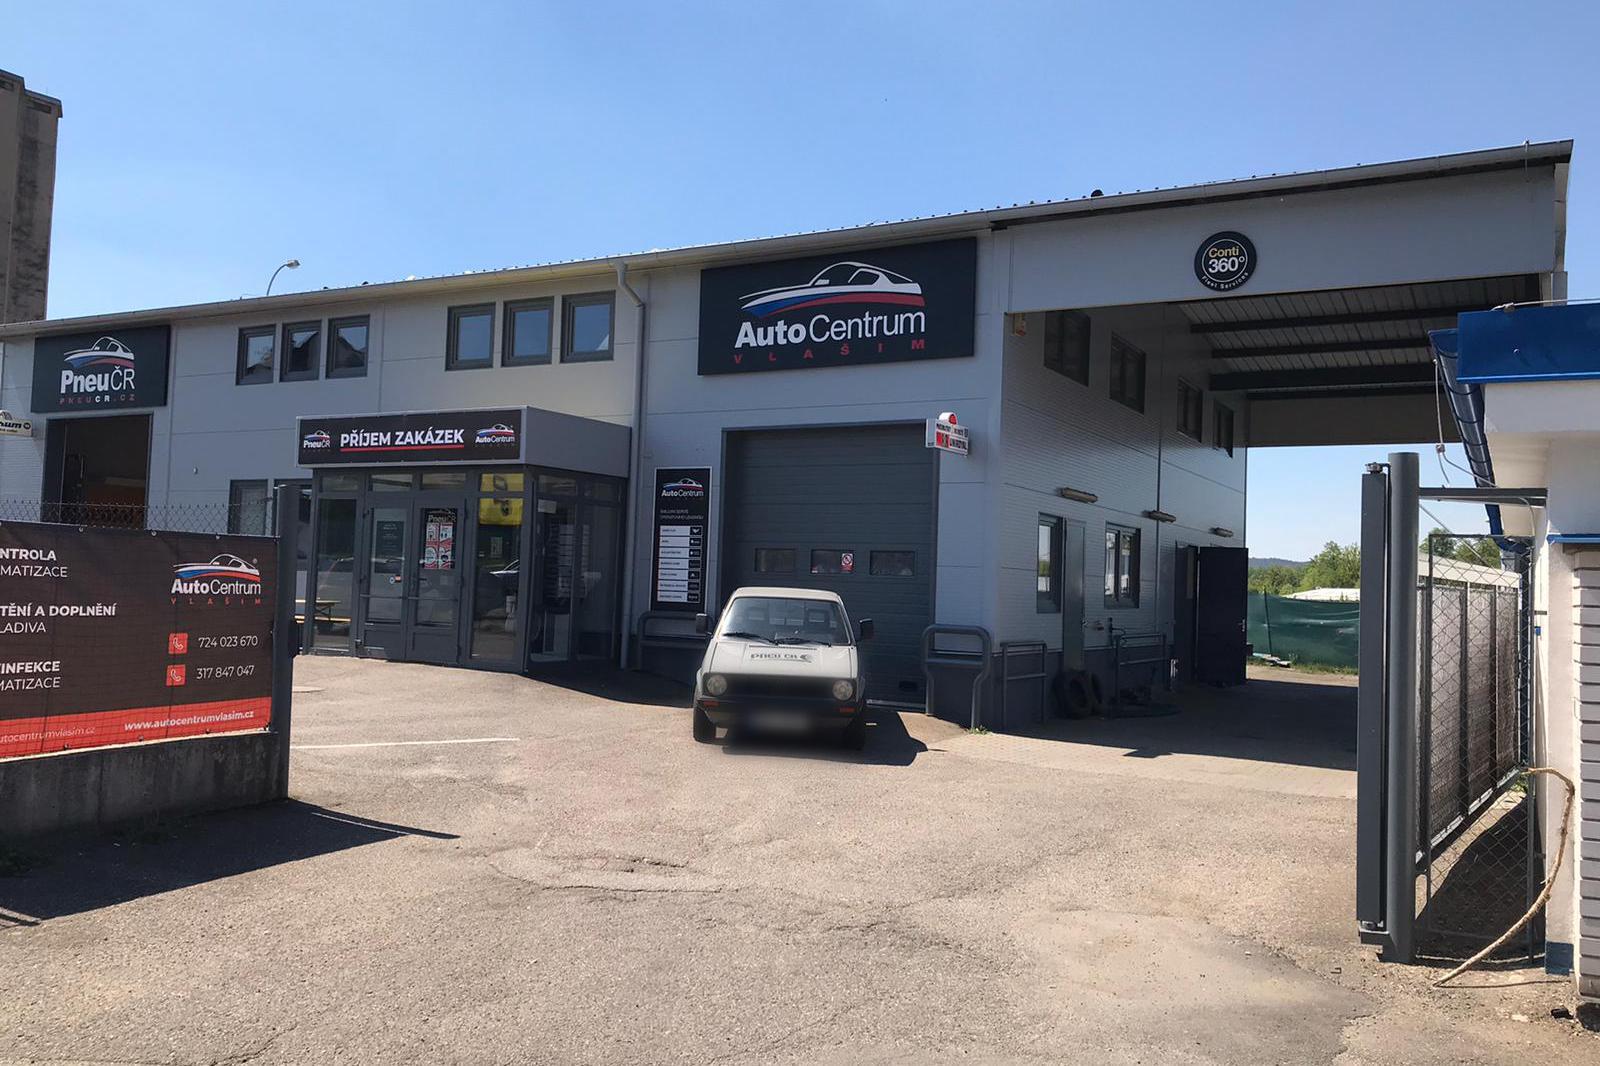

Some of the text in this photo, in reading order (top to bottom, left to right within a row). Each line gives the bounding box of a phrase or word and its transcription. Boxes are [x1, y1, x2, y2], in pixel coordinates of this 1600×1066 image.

[1208, 246, 1240, 258] Conti
[734, 310, 926, 349] AutoCentrum
[734, 339, 925, 365] VLAŠIM
[60, 365, 136, 394] PneuČR
[340, 426, 465, 448] PŘÍJEM ZAKÁZEK
[475, 435, 516, 444] AutoCentrum
[661, 489, 705, 497] AutoCentrum
[171, 578, 261, 595] AutoCentrum
[0, 602, 117, 617] TĚNÍ A DOPLNĚNÍ
[198, 635, 259, 648] 724 023 670
[0, 660, 61, 675] INFEKCE
[196, 664, 255, 680] 317 847 047
[124, 709, 255, 731] www.autocentrumvlasim.cz
